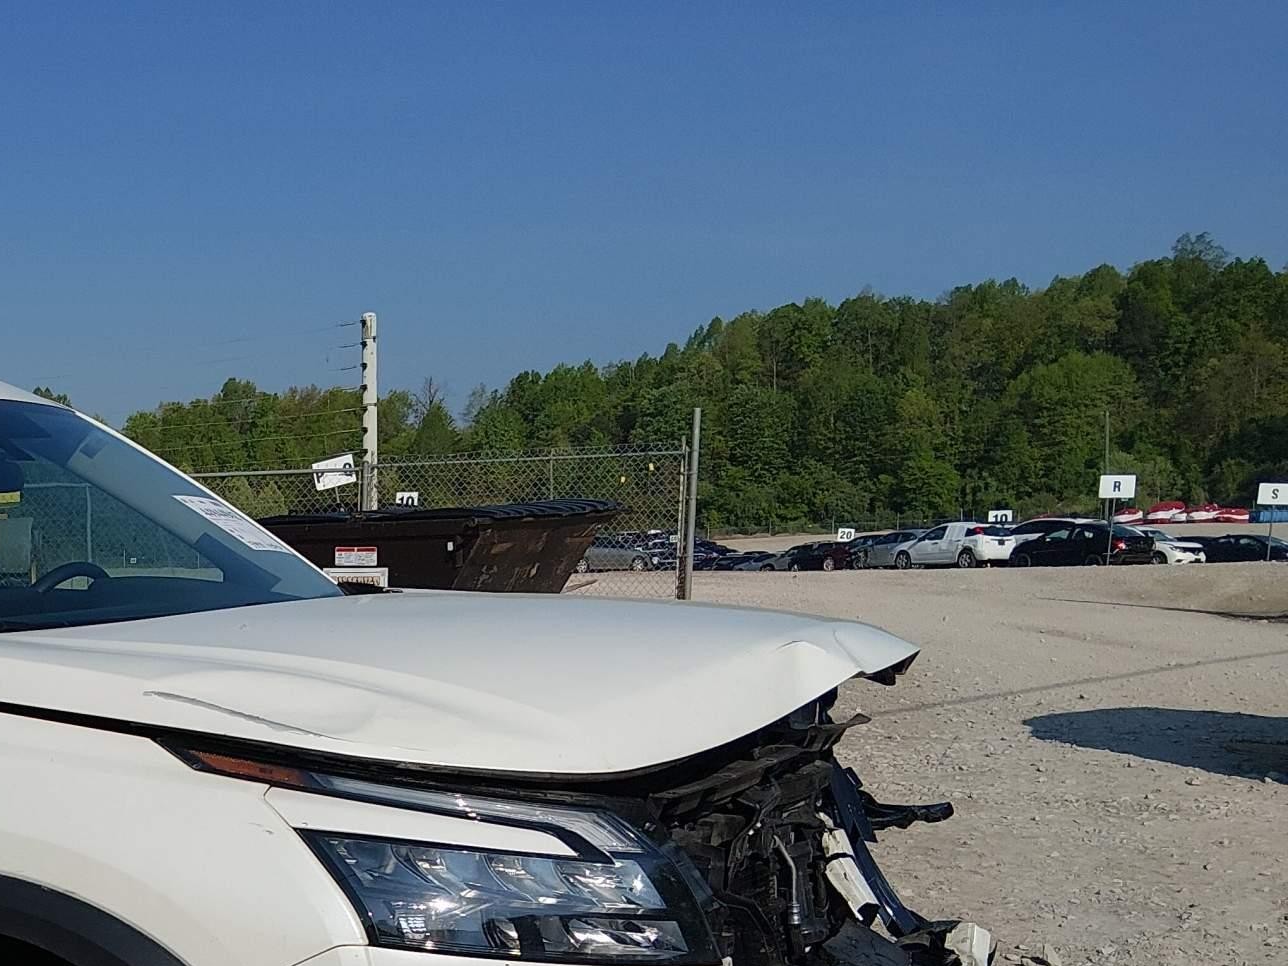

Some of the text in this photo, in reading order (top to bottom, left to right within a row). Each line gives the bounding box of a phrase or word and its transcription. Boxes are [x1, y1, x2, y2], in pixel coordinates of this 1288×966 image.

[1113, 480, 1122, 492] R
[1271, 488, 1280, 500] S
[398, 495, 415, 506] 10
[993, 513, 1009, 524] 10
[839, 530, 852, 540] 20
